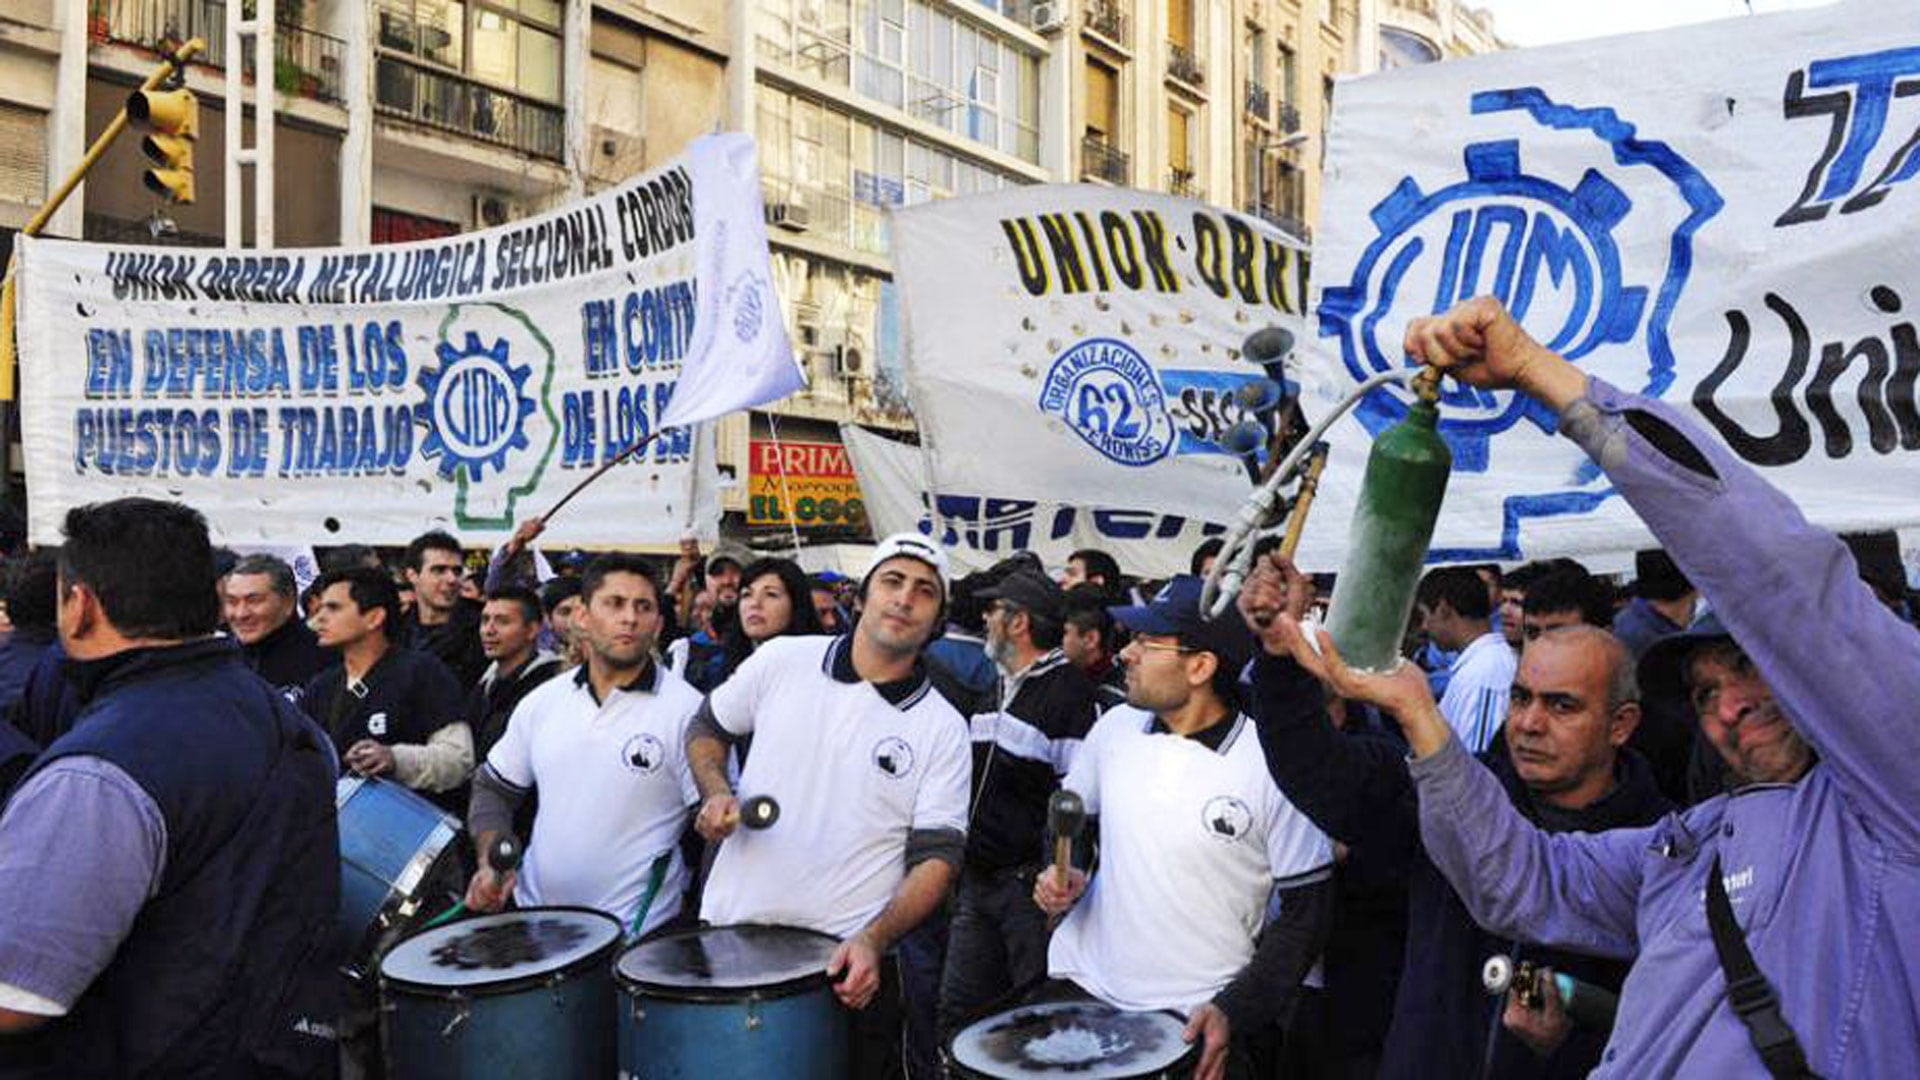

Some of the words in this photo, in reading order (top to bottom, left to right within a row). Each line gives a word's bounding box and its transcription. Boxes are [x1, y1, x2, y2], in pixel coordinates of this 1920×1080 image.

[105, 251, 198, 300] UNION
[197, 256, 305, 303] OBRERA
[307, 238, 486, 303] METALURGICA
[491, 203, 613, 289] SECCIONAL
[1000, 210, 1180, 296] UNION
[84, 328, 132, 399] EN
[141, 327, 291, 399] DEFENSA
[297, 324, 338, 397] DE
[344, 320, 408, 396] LOS
[582, 299, 620, 379] EN
[622, 277, 697, 375] CONTR
[1078, 382, 1141, 438] 62
[1181, 387, 1245, 441] SEC
[1692, 284, 1920, 467] Uni
[73, 407, 221, 476] PUESTOS
[226, 407, 268, 478] DE
[278, 404, 414, 478] TRABAJO
[561, 390, 596, 469] DE
[602, 384, 649, 465] LOS
[750, 495, 786, 521] EL
